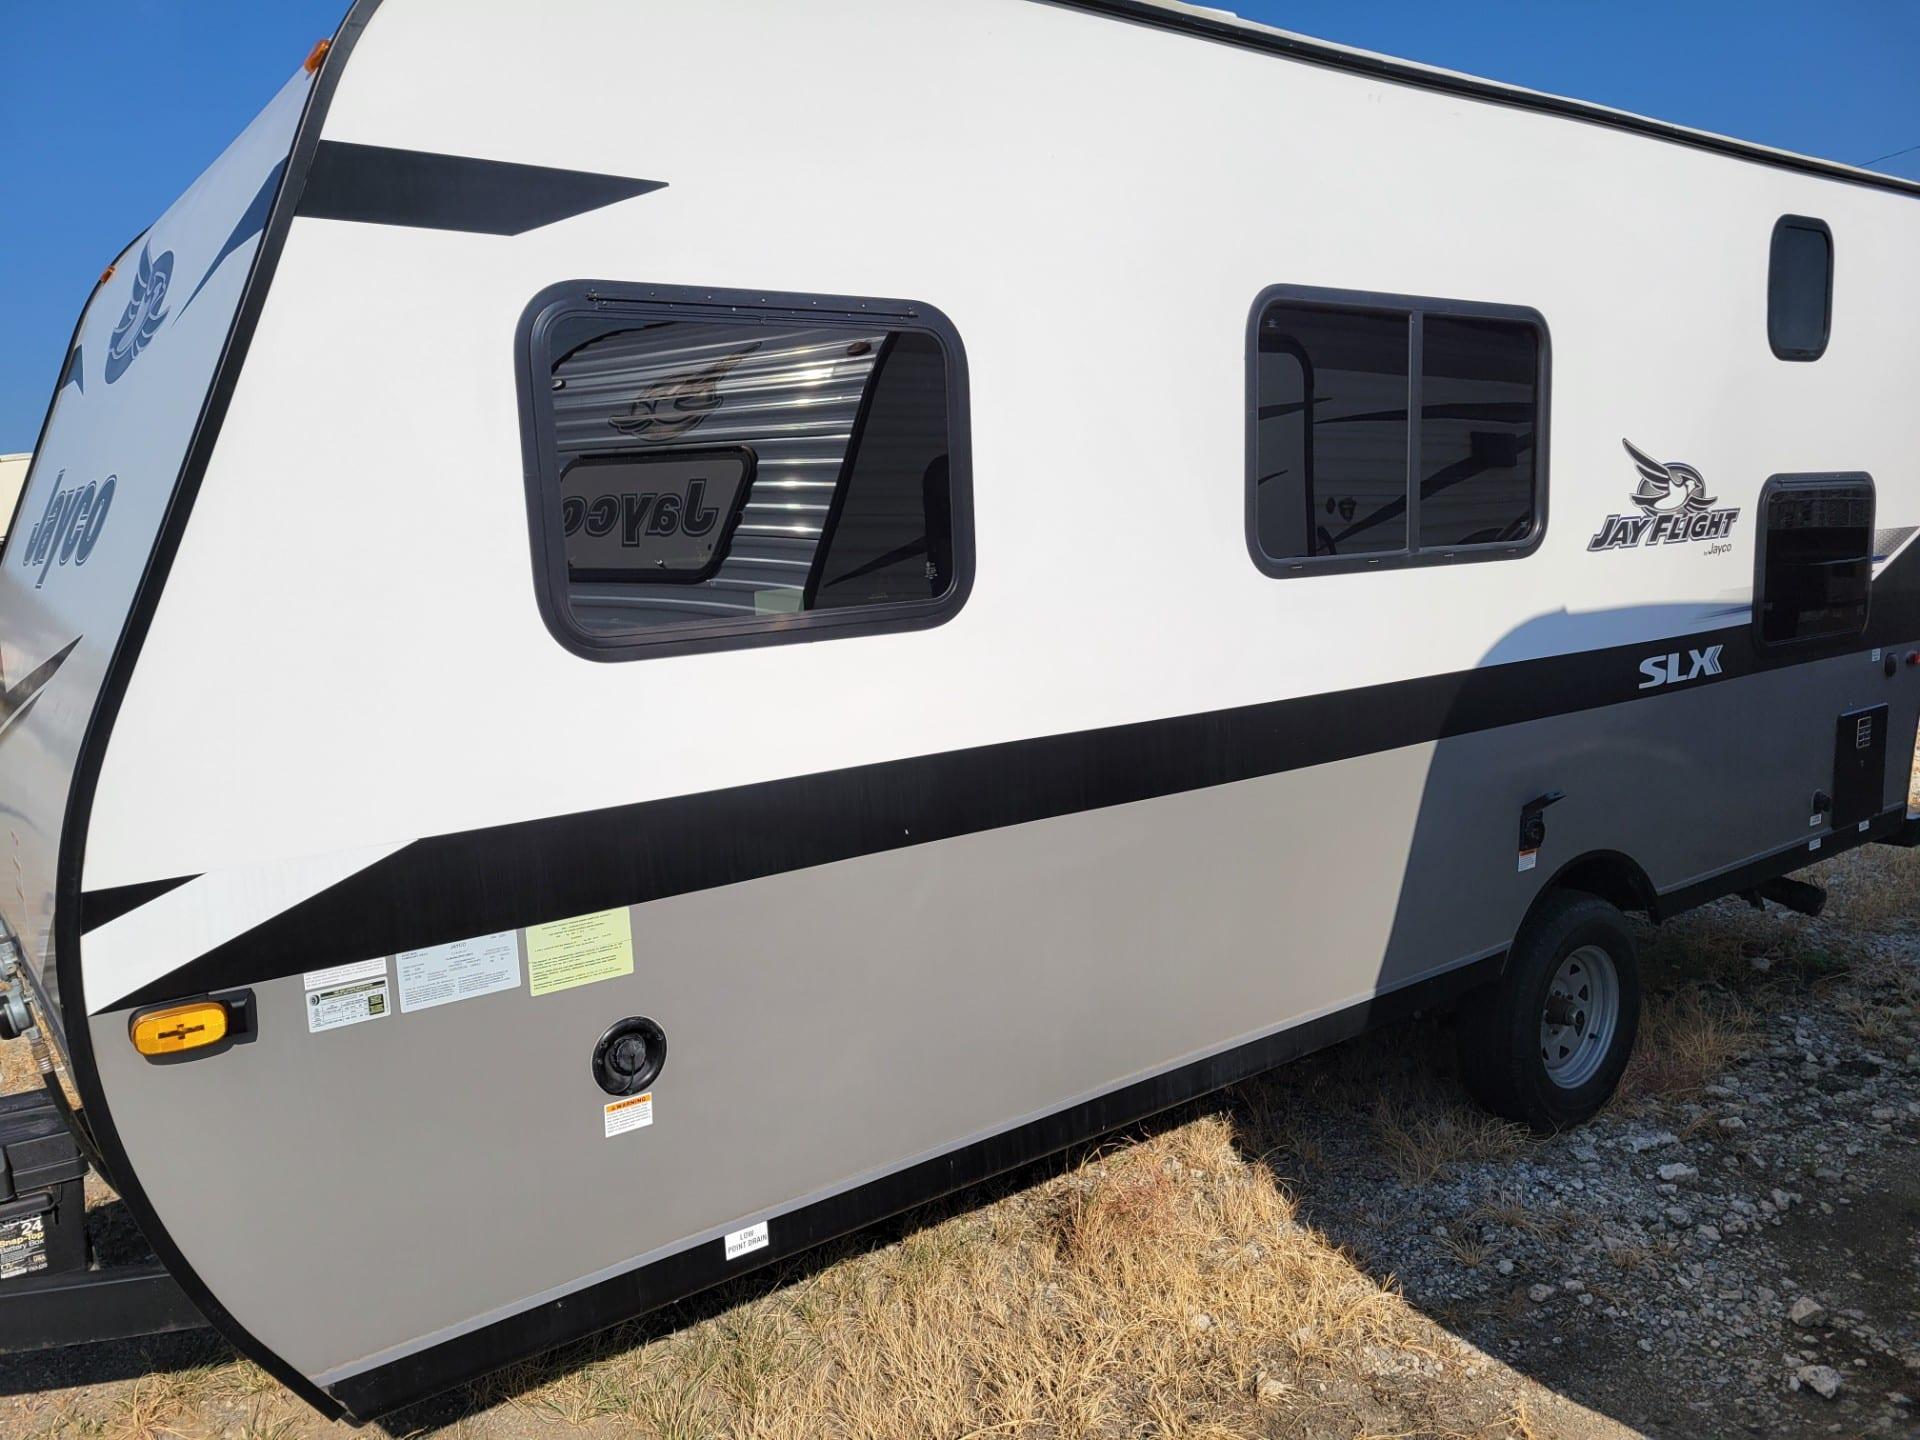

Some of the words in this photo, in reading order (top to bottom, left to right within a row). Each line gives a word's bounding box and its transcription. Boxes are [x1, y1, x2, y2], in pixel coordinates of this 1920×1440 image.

[23, 468, 117, 588] Jayco
[1587, 514, 1652, 552] JAY
[1646, 508, 1741, 546] FLIGHT
[1638, 645, 1724, 690] SLX
[616, 1096, 648, 1110] WARNING
[21, 1219, 44, 1236] 24
[728, 1240, 746, 1254] POINT
[748, 1233, 767, 1246] DRAIN
